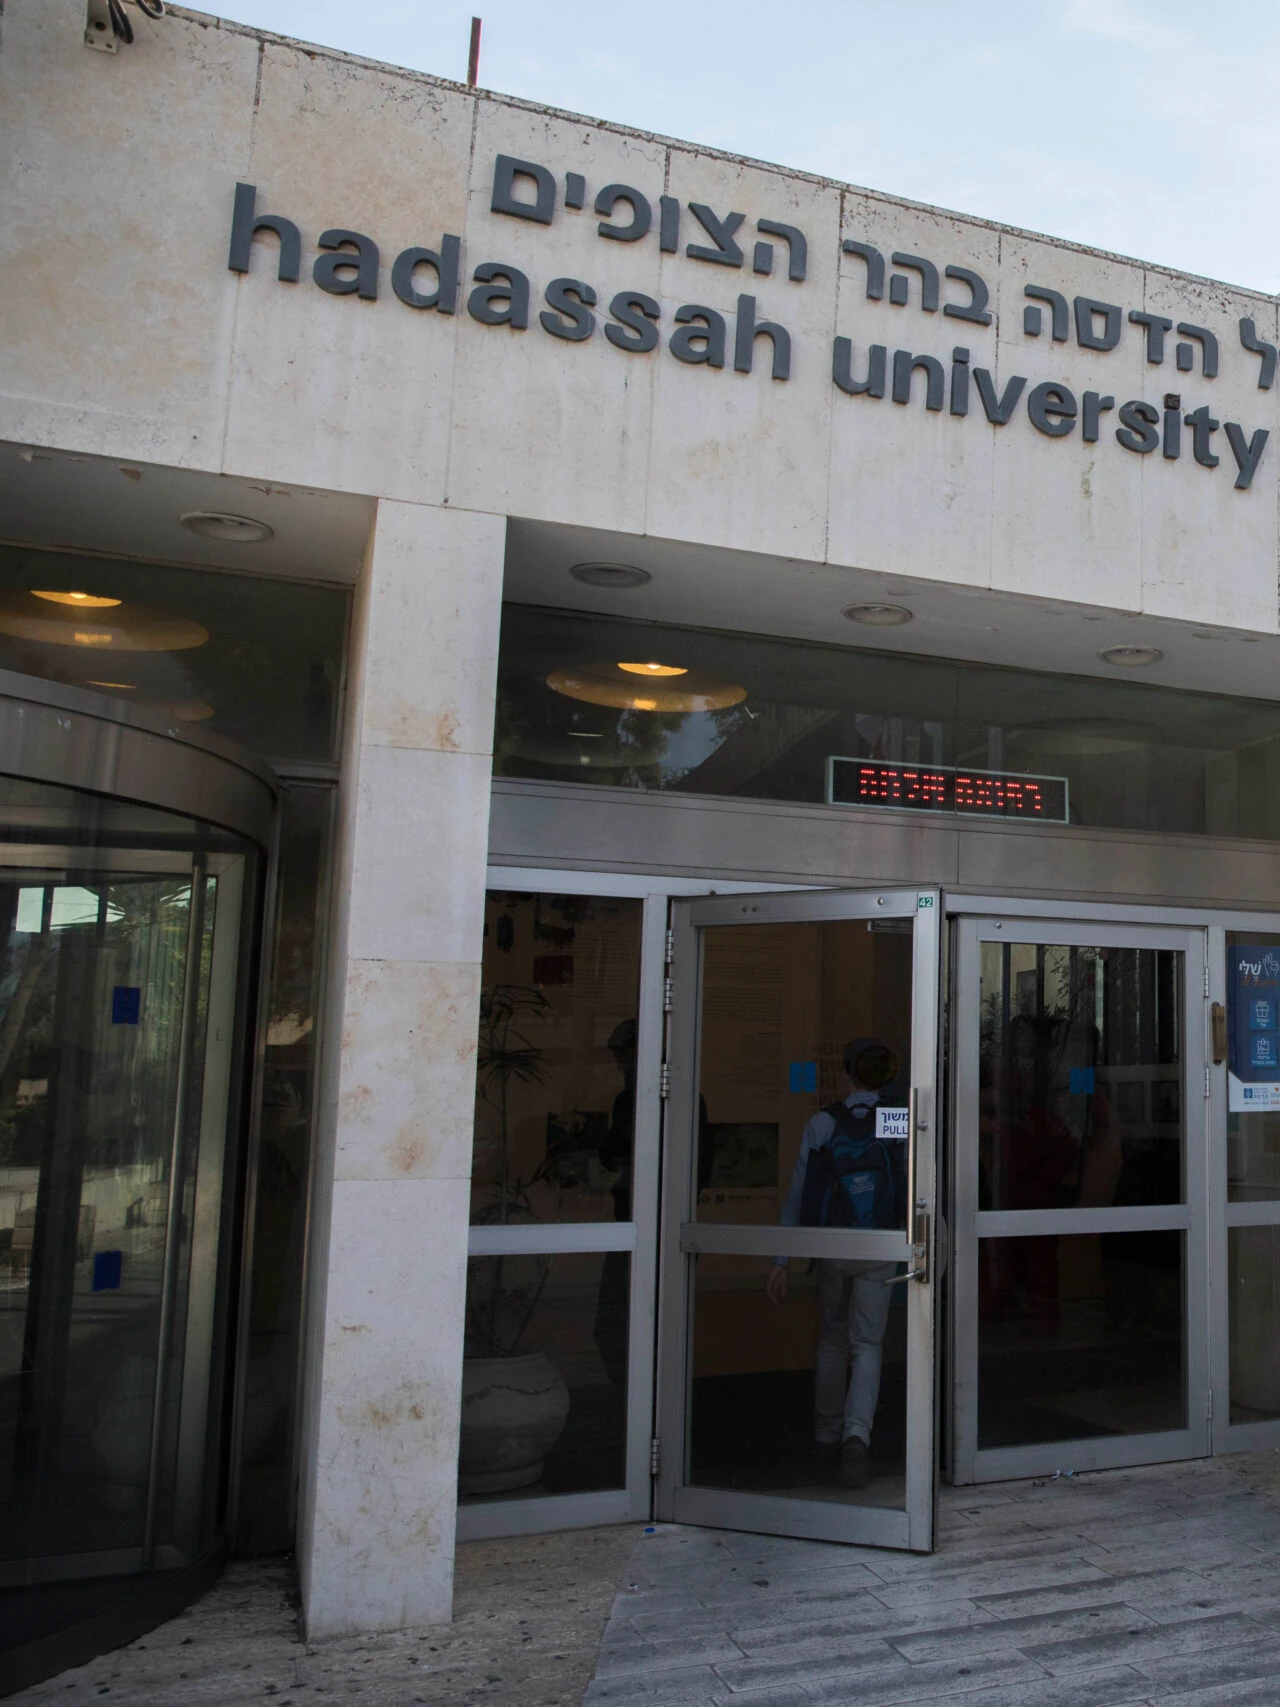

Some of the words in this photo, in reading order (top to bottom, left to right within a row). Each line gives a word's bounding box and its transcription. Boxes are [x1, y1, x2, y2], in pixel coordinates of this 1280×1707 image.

[490, 153, 808, 284] הצופים
[838, 239, 993, 327] בהר
[228, 181, 792, 383] hadassah
[831, 335, 1270, 491] university
[1023, 284, 1220, 380] הדסה
[919, 898, 932, 907] 42
[881, 1112, 909, 1124] משוך
[883, 1125, 909, 1135] PULL
